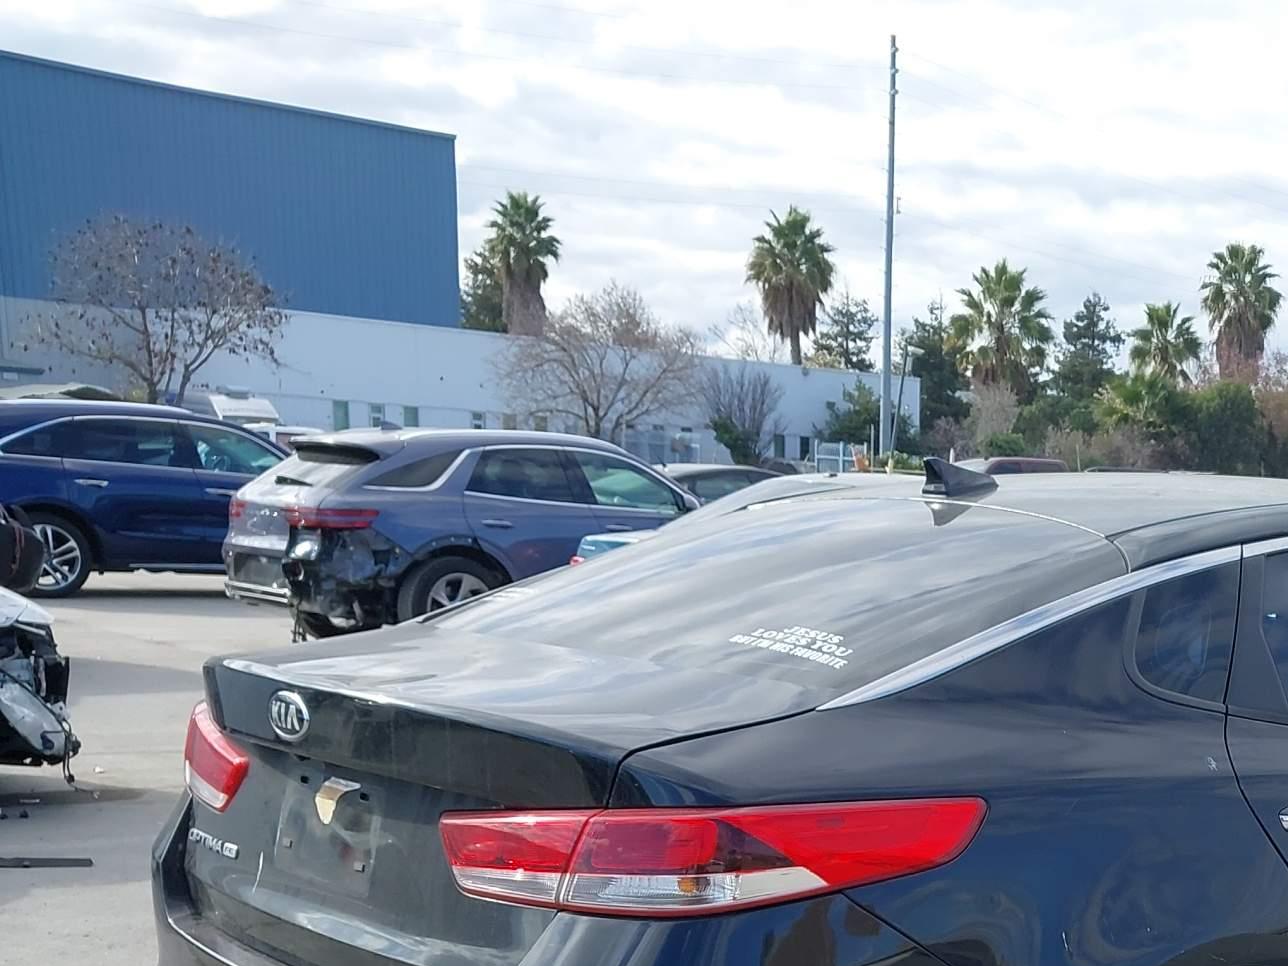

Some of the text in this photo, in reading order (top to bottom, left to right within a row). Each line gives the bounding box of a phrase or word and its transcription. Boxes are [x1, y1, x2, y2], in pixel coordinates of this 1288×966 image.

[751, 628, 853, 657] LOVES YOU
[784, 626, 844, 643] JESUS
[729, 634, 758, 645] BUT
[769, 642, 795, 653] HIS
[789, 647, 849, 670] FAVORITE
[271, 700, 300, 732] KIA
[187, 827, 224, 854] OPTIMA
